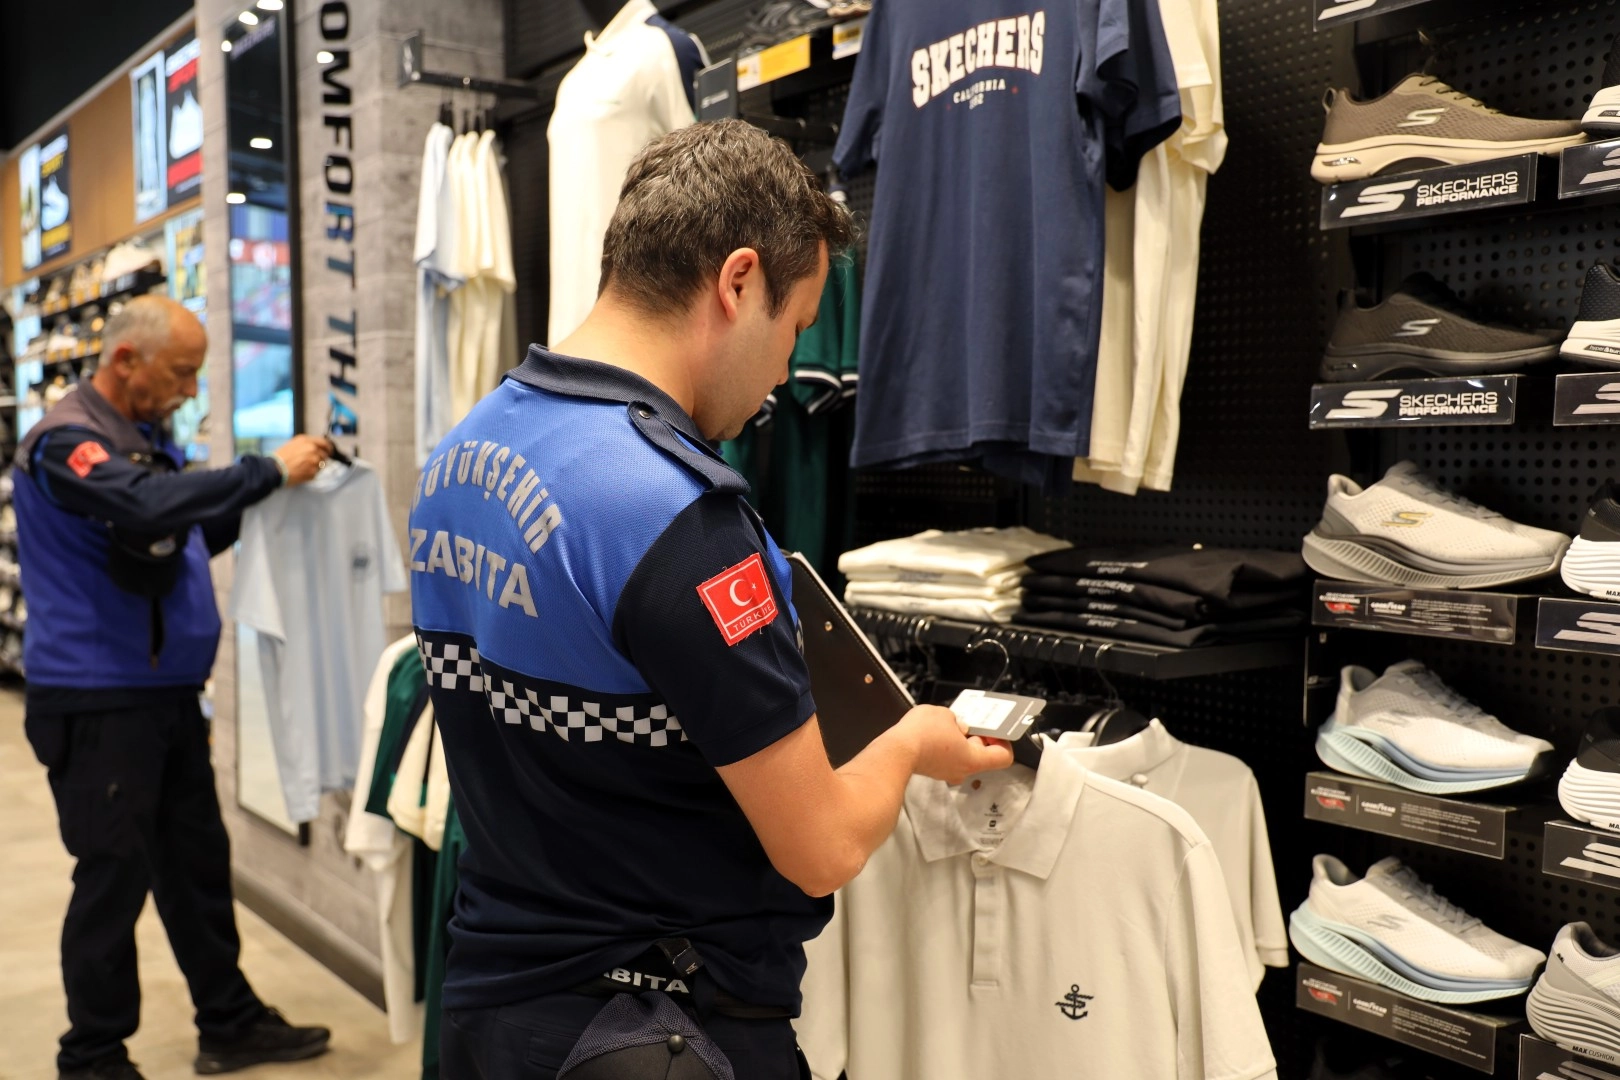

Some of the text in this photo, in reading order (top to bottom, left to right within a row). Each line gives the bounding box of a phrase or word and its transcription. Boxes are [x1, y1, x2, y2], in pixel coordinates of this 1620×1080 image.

[911, 10, 1046, 108] SKECHERS
[953, 78, 1006, 104] CALIFORNIA
[1416, 183, 1518, 207] PERFORMANCE
[1417, 171, 1518, 198] SKECHERS
[327, 310, 358, 458] THA
[1399, 391, 1498, 408] SKECHERS
[1399, 404, 1498, 417] PERFORMANCE
[409, 528, 539, 618] ZABITA
[1572, 1045, 1588, 1054] MAX
